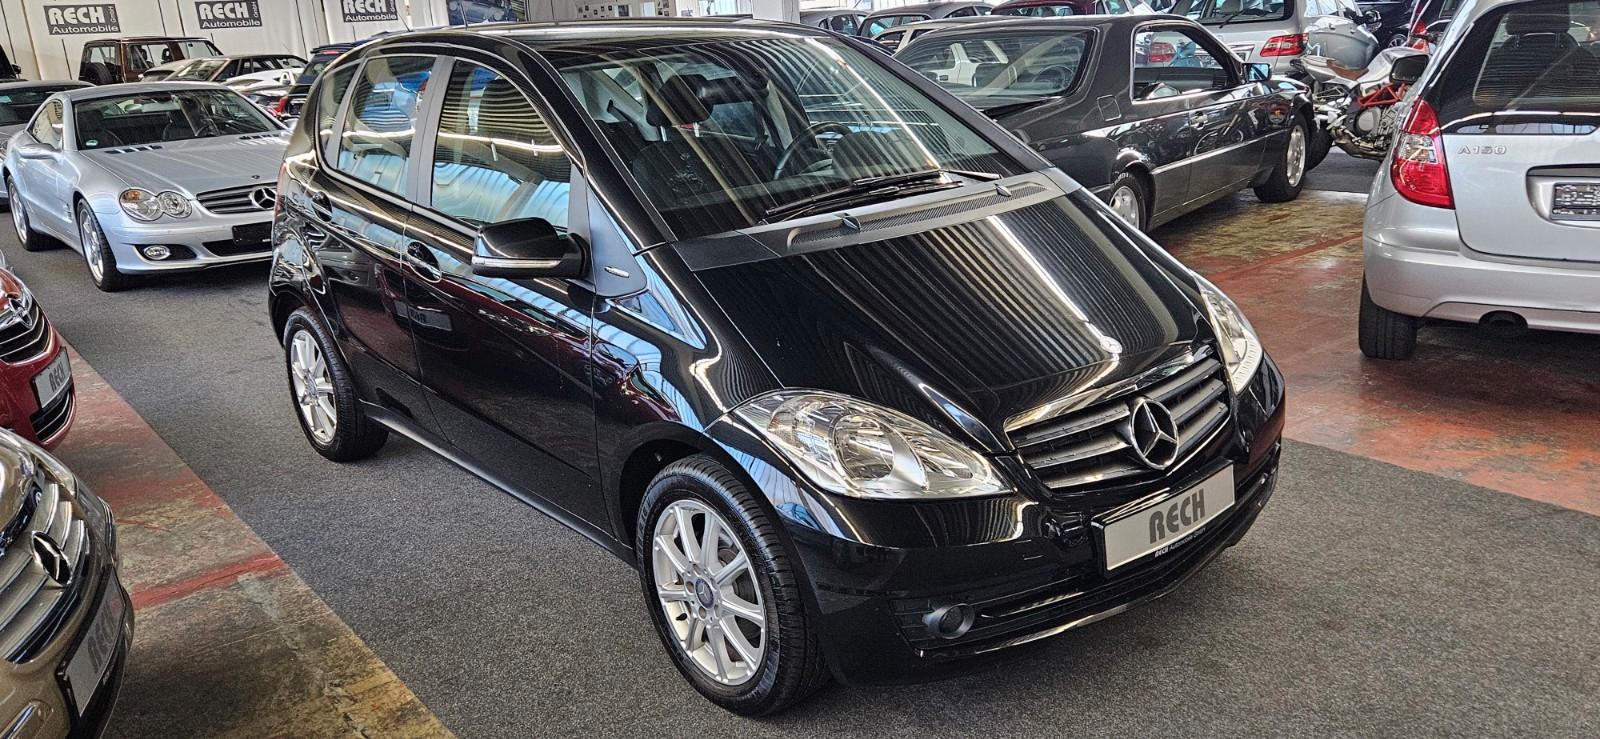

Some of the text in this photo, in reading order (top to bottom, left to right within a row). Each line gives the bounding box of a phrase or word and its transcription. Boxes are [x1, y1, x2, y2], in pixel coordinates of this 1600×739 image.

[198, 2, 249, 19] RECH
[342, 0, 387, 13] RECH
[48, 7, 105, 25] RECH
[202, 19, 260, 28] Automobile
[52, 25, 118, 33] Automobile
[1149, 488, 1205, 544] RECH
